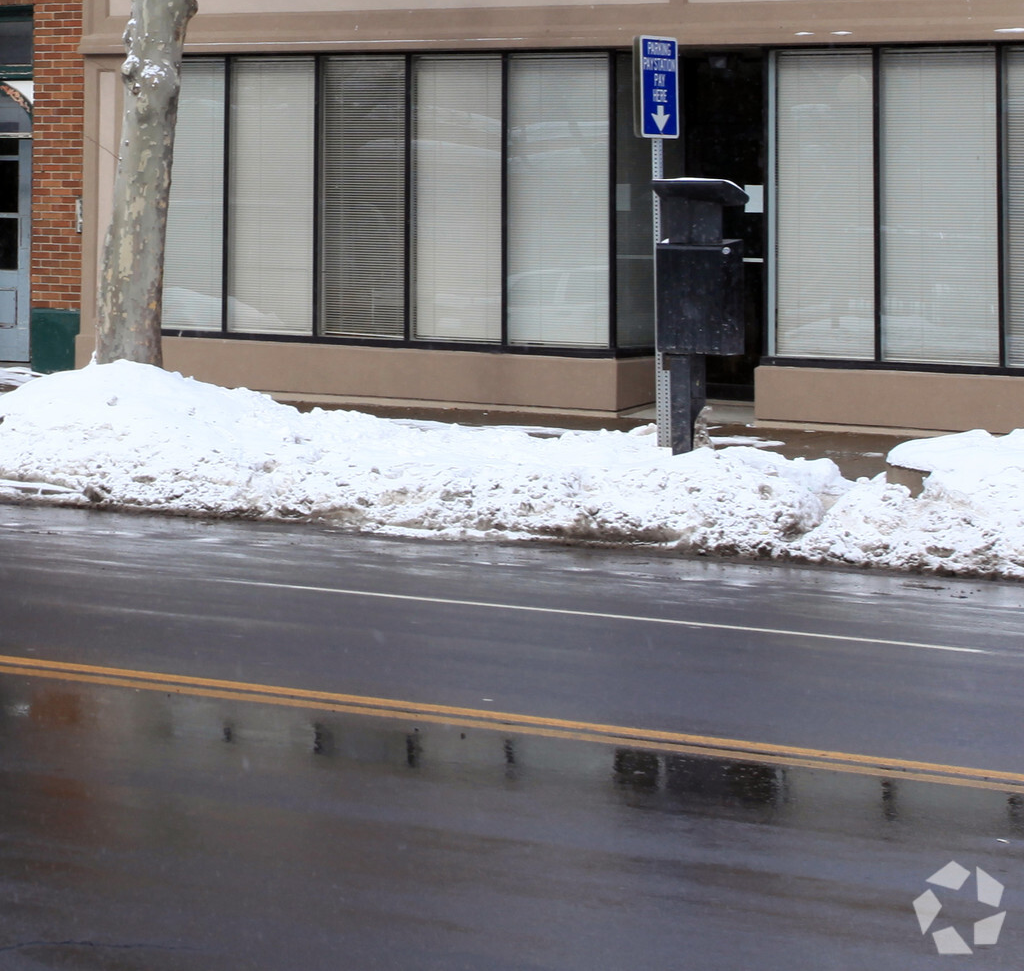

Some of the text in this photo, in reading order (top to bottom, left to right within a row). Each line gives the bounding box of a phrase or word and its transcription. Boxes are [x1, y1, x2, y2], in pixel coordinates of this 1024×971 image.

[647, 41, 672, 56] PARKING
[654, 73, 666, 87] PAY
[652, 89, 668, 102] HERE
